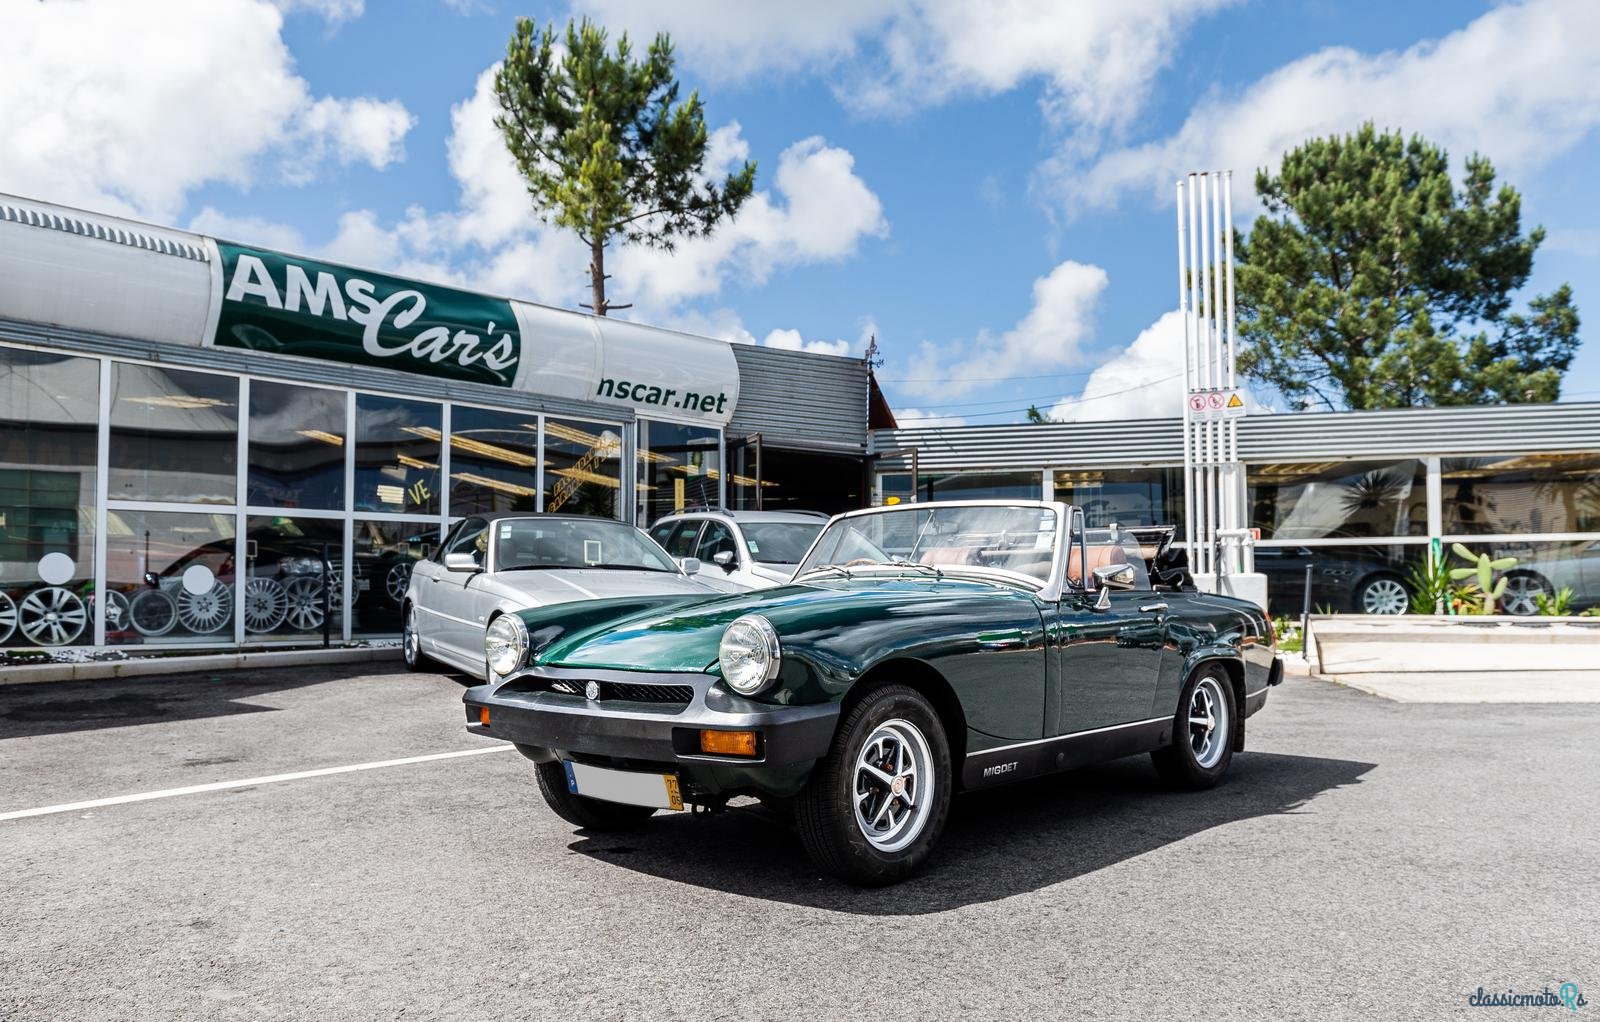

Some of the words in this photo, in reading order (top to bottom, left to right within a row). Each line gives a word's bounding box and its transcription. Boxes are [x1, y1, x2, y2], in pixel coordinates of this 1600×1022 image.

[225, 253, 382, 326] AMS
[362, 289, 518, 371] Car's
[983, 761, 1019, 778] MIGDET
